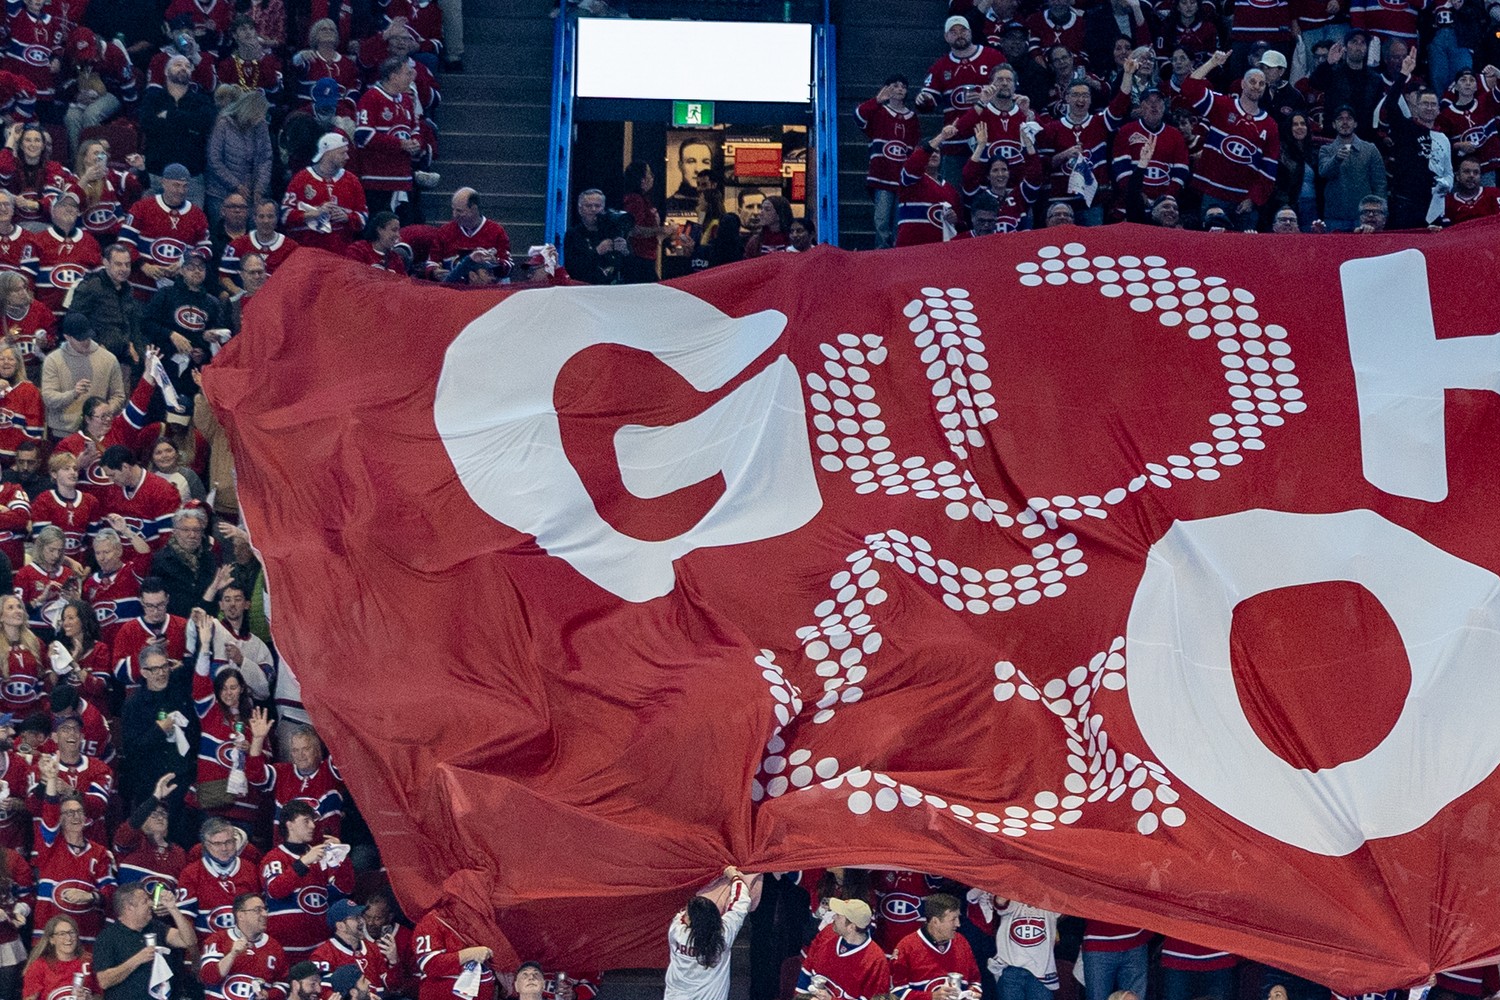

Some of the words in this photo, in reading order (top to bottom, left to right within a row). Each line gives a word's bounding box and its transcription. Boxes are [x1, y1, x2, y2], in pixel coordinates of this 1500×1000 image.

[263, 860, 283, 878] 48
[415, 935, 432, 953] 21
[267, 955, 276, 970] C
